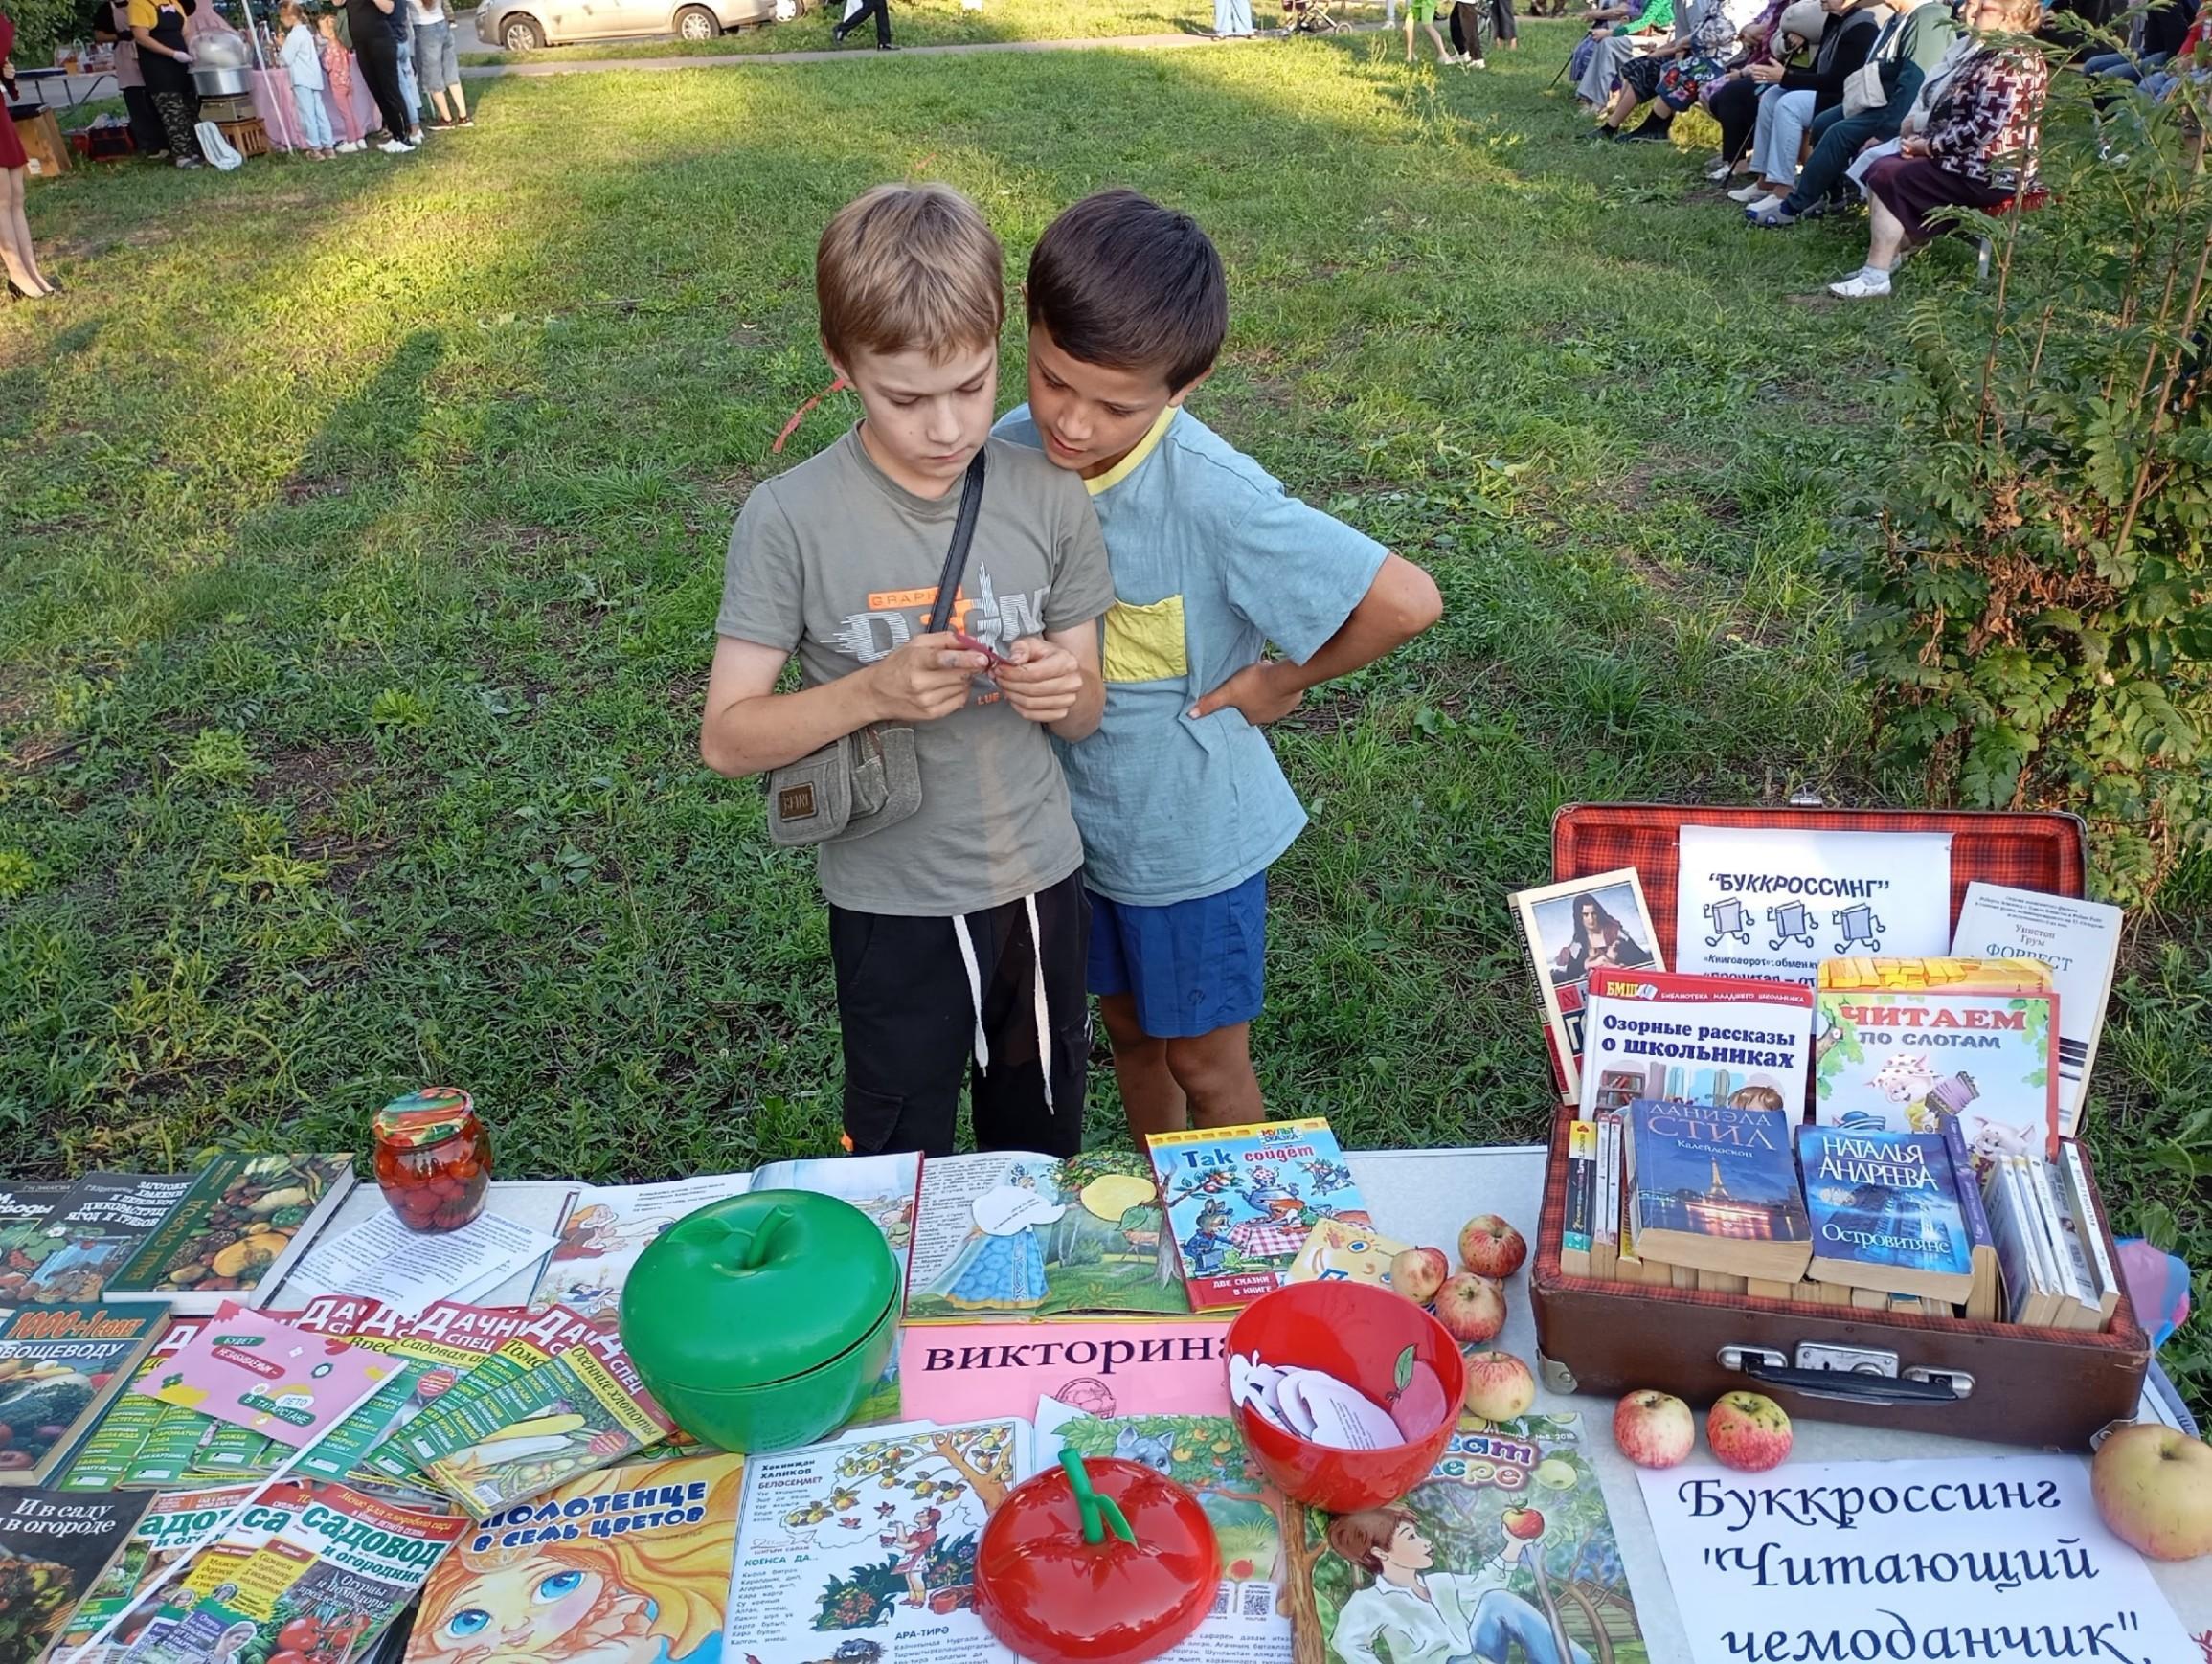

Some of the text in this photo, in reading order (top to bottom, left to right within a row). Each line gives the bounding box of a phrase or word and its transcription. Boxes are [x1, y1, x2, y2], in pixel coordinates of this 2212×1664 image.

[2016, 924, 2055, 938] Уинстон
[2020, 934, 2044, 946] Грум
[1758, 994, 1805, 1002] ШКОЛЬНИКА
[1840, 1006, 2027, 1030] ЧИТАЕМ
[1602, 1015, 1796, 1046] Озорные рассказы
[1859, 1032, 2001, 1049] ПО СЛОГАМ
[1602, 1037, 1794, 1068] о школьниках
[1650, 1104, 1772, 1127] ДАНИЭЛА
[1648, 1115, 1777, 1151] СТИЛ
[1182, 1144, 1315, 1169] Так сойдём
[1677, 1139, 1754, 1158] Калейдоскоп
[1822, 1136, 1925, 1166] НАТАЛЬЯ
[1819, 1156, 1940, 1192] АНДРЕЕВА
[64, 1211, 102, 1223] ЯГОД
[114, 1214, 162, 1227] ГРИБОВ
[155, 1199, 208, 1248] ОГОРОД
[1822, 1224, 1952, 1254] Островитяне
[1213, 1275, 1270, 1289] ДВЕ СКАЗКИ
[1243, 1285, 1272, 1294] КНИГЕ
[223, 1337, 255, 1345] БУДЕТ
[400, 1338, 468, 1360] Садовая
[445, 1333, 497, 1353] СПЕЦ
[610, 1359, 644, 1396] СПЕЦ
[281, 1396, 308, 1407] ЛЕТО
[571, 1346, 615, 1390] Осенние
[607, 1388, 659, 1436] хлопоты
[243, 1395, 310, 1425] В ТАТАРСТАНЕ
[759, 1468, 812, 1479] ХАЛИКОВ
[12, 1498, 114, 1521] И в саду
[479, 1481, 708, 1531] ПОЛОТЕНЦЕ
[1678, 1477, 2065, 1532] Буккроссинг
[5, 1519, 117, 1538] в огороде
[302, 1505, 446, 1572] садовод
[472, 1534, 494, 1554] В
[501, 1522, 580, 1549] СЕМЬ
[589, 1505, 706, 1540] ЦВЕТОВ
[321, 1544, 334, 1557] и
[335, 1546, 425, 1584] огородник
[744, 1556, 787, 1567] КОЕНСА
[1704, 1537, 2100, 1594] "Читающий
[340, 1574, 388, 1597] Огурцы
[894, 1626, 950, 1640] АРА-ТИРӘ
[1720, 1608, 2153, 1664] чемоданчик"
